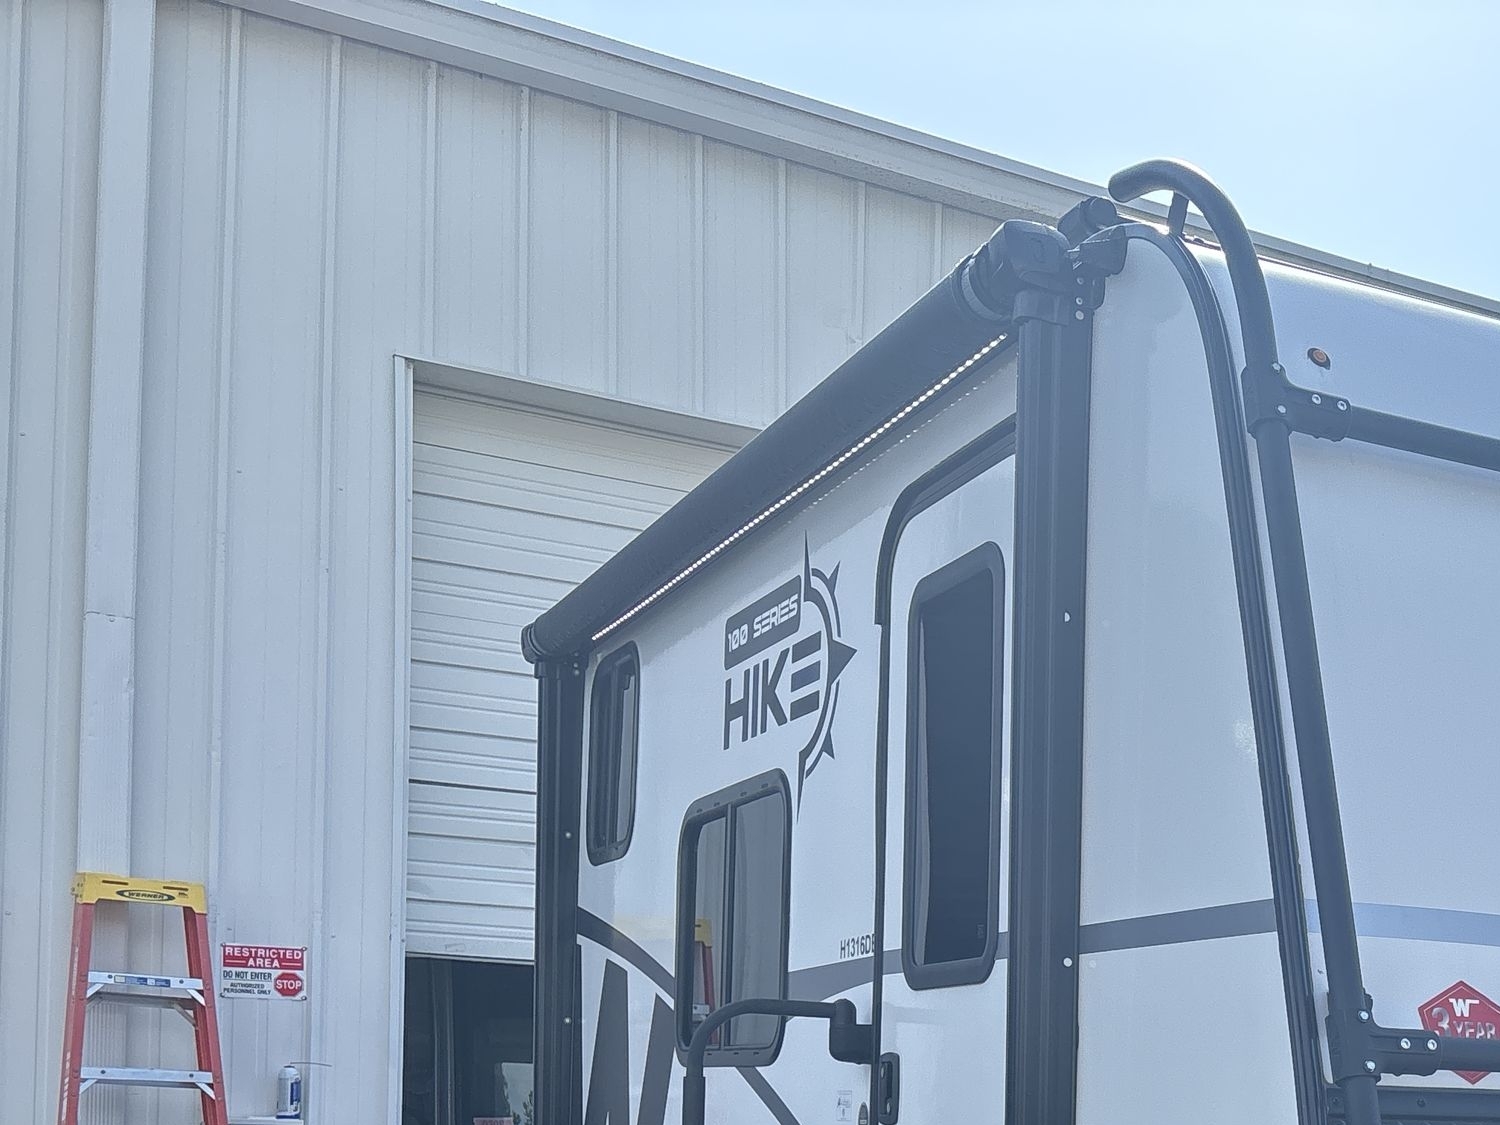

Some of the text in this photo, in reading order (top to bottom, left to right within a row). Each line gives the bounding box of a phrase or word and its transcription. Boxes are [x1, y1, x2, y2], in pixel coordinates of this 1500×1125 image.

[728, 593, 799, 652] 100 SERIES
[723, 630, 822, 751] HIKE
[128, 891, 165, 900] WERNER
[225, 947, 302, 960] RESTRICTED
[247, 958, 280, 968] AREA
[223, 970, 272, 980] DO NOT ENTER
[276, 980, 302, 989] STOP
[1453, 1021, 1496, 1039] YEAR
